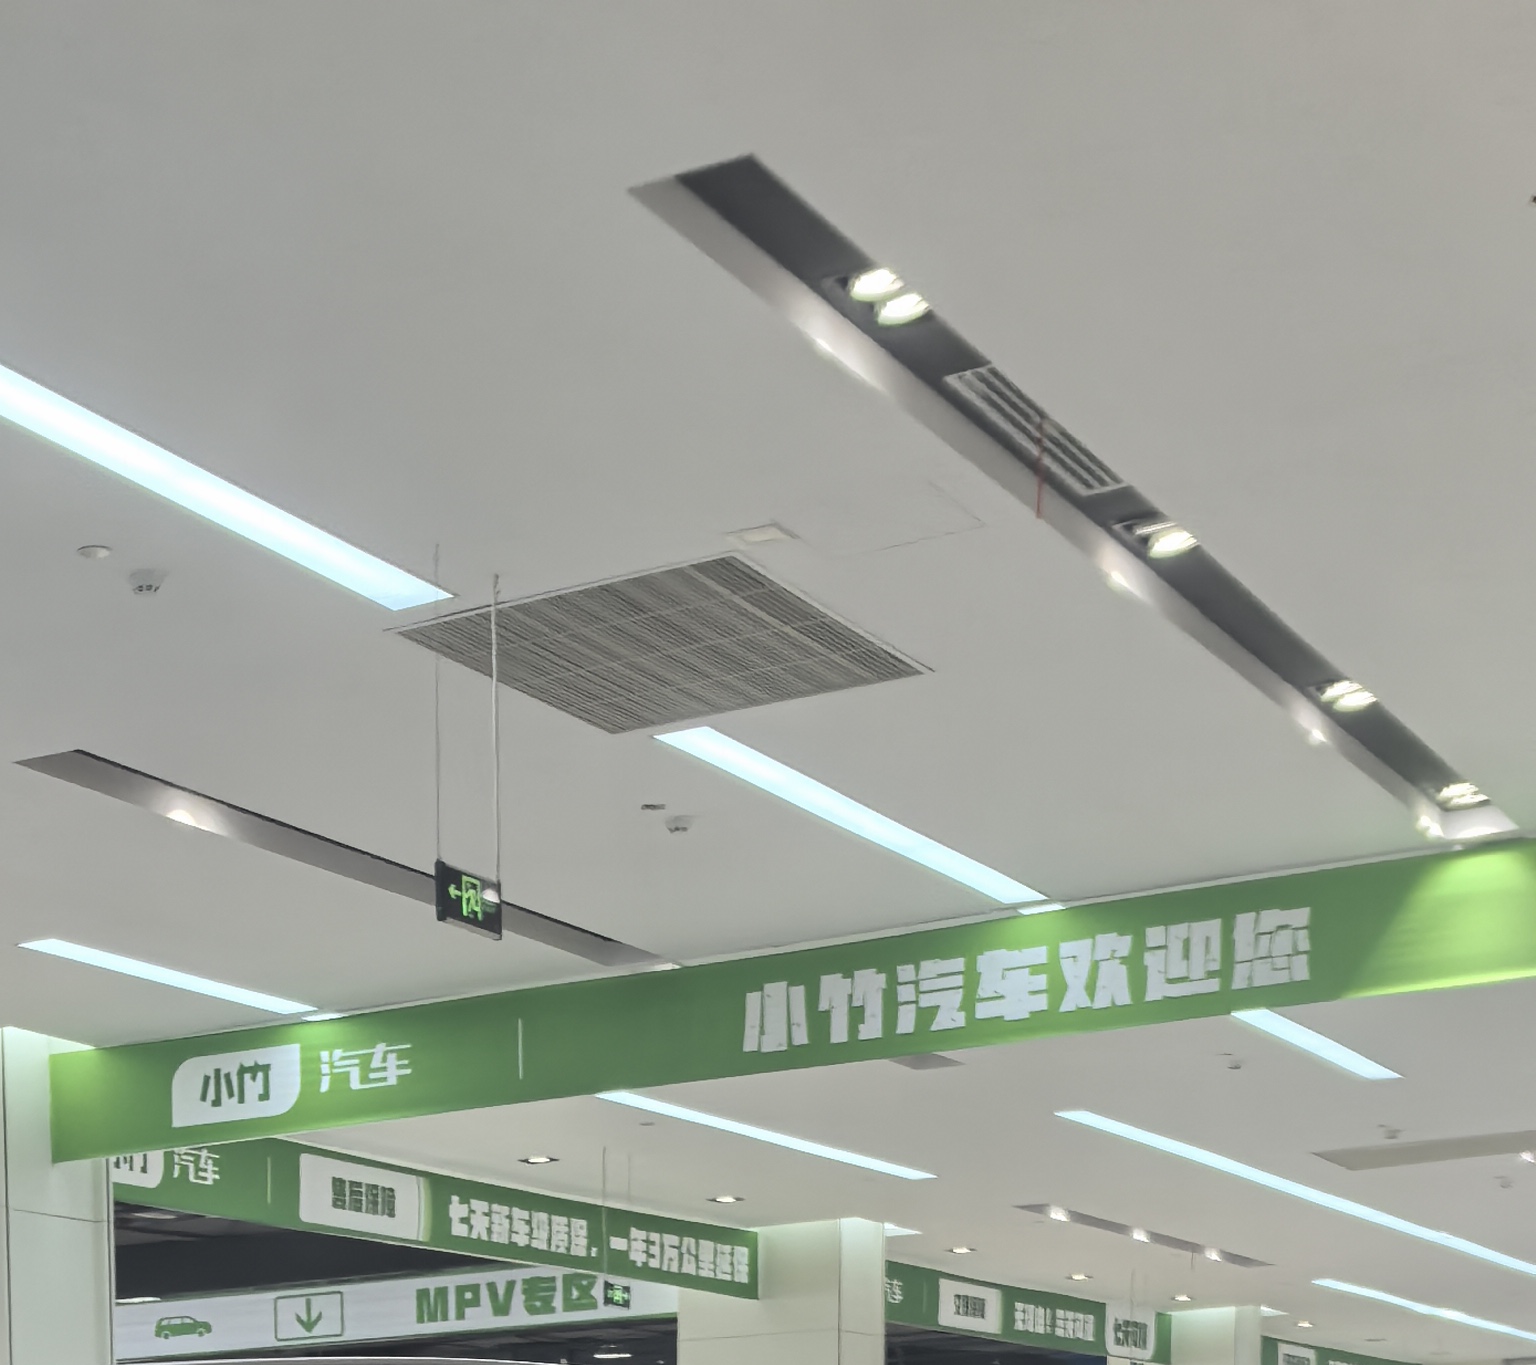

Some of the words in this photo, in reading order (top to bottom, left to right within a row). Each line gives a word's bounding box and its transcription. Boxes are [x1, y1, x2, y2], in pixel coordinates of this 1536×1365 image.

[743, 907, 1311, 1053] 小竹汽车欢迎您
[199, 1060, 272, 1107] 小竹
[319, 1043, 413, 1093] 汽车
[415, 1272, 599, 1325] MPV专区
